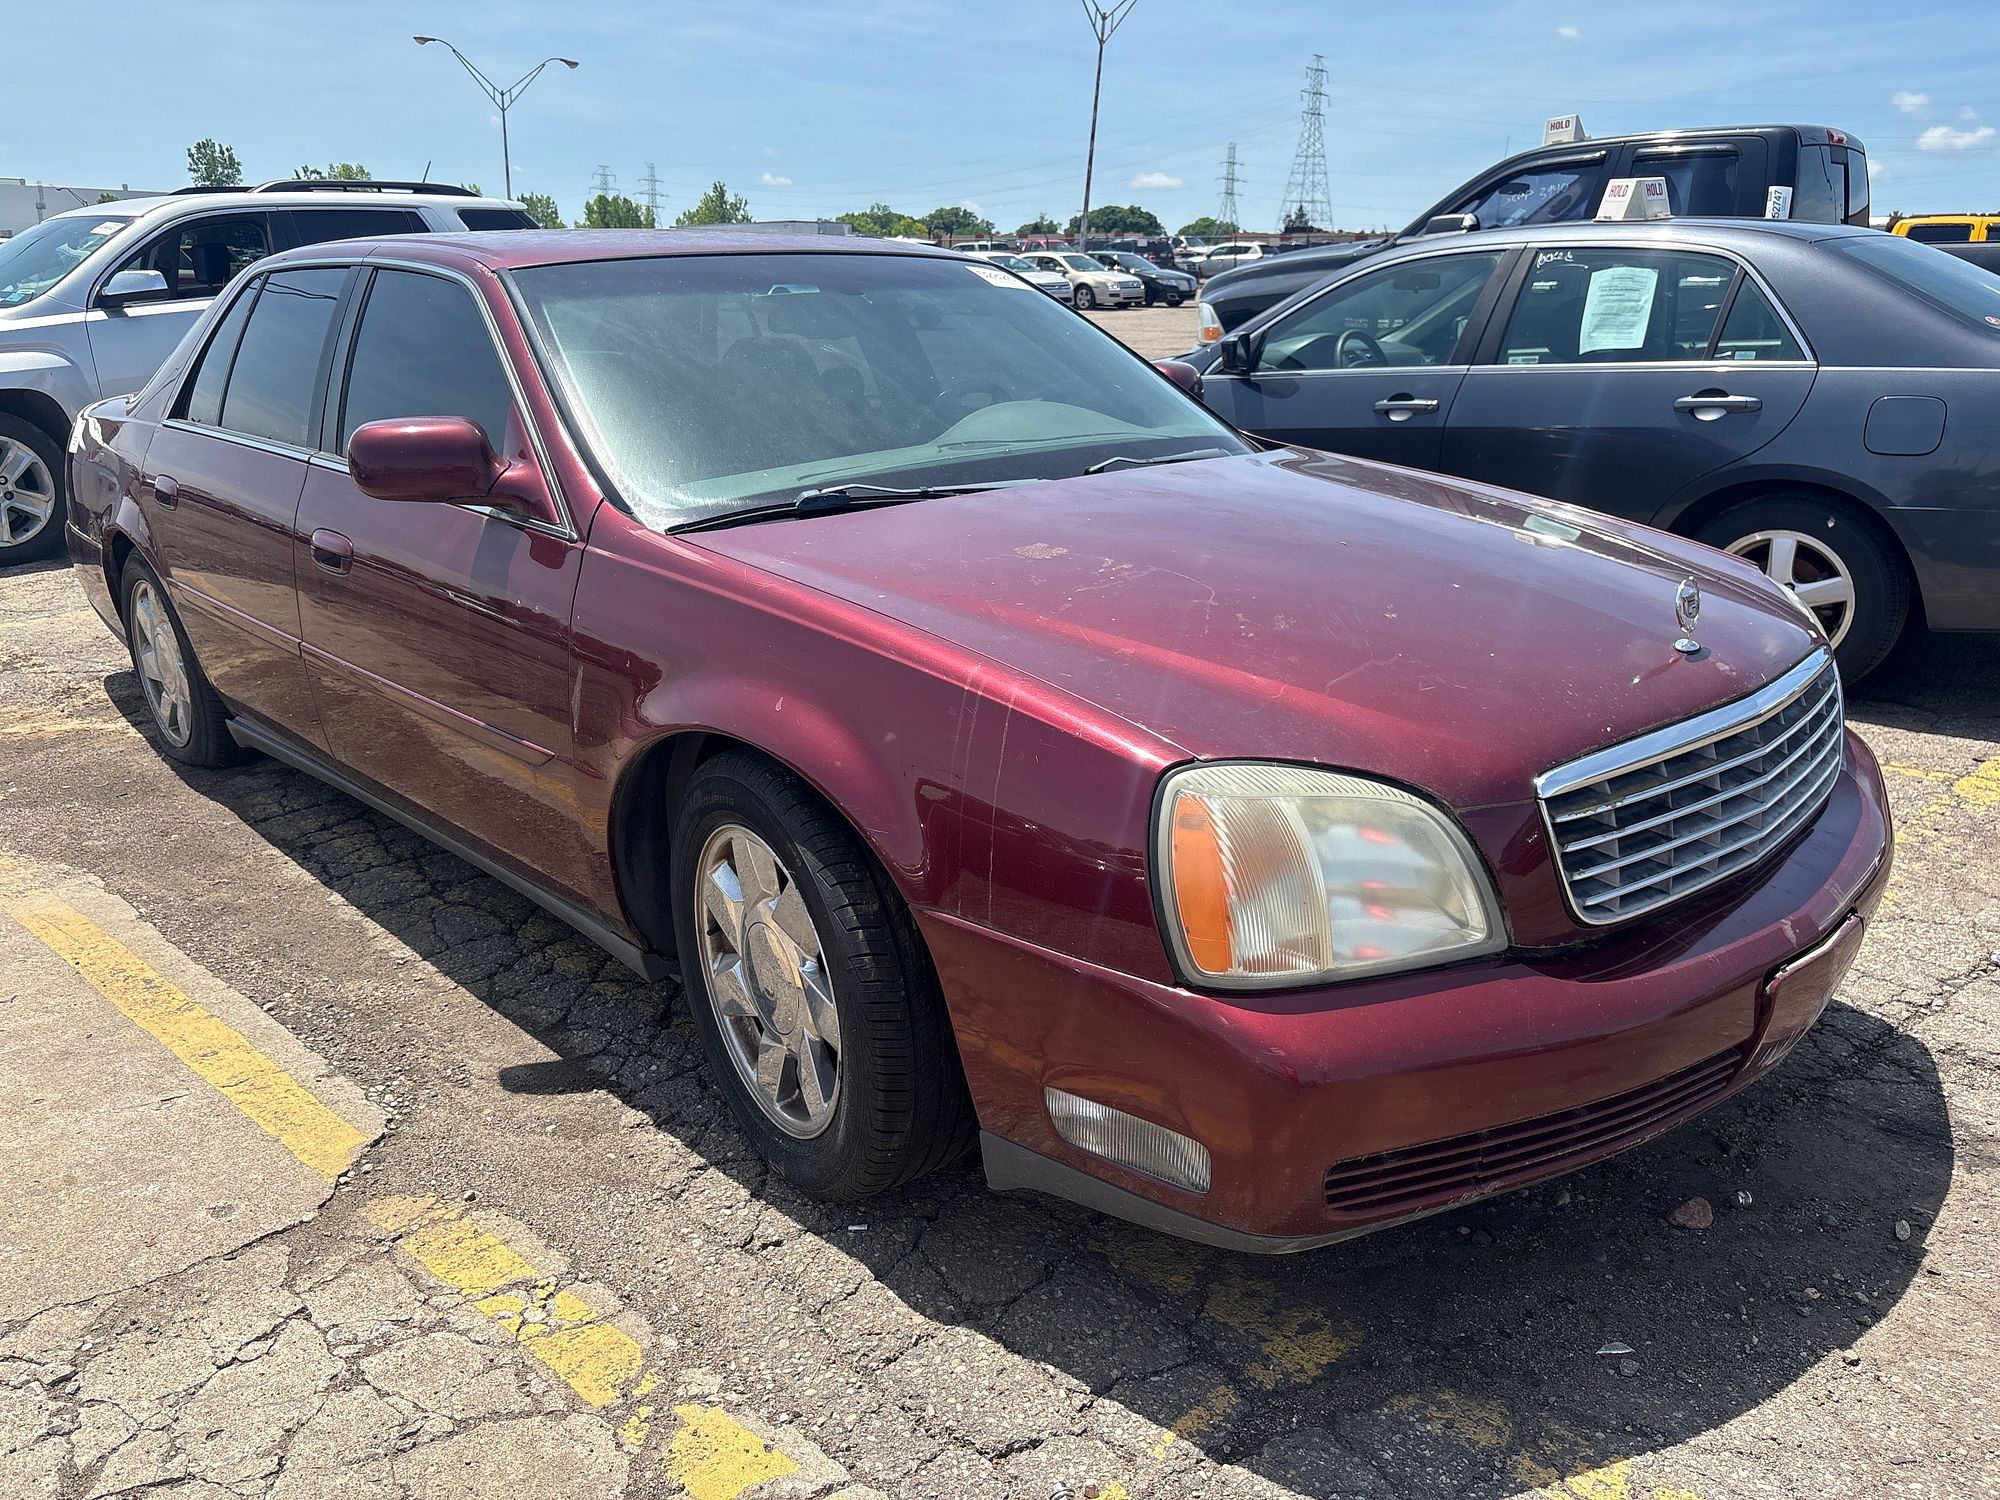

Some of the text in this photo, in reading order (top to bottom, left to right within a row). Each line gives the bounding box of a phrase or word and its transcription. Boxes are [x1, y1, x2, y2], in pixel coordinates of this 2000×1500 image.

[1550, 119, 1570, 131] HOLD
[1608, 184, 1629, 199] HOLD
[1646, 183, 1663, 197] HOLD
[701, 794, 735, 806] OURING
